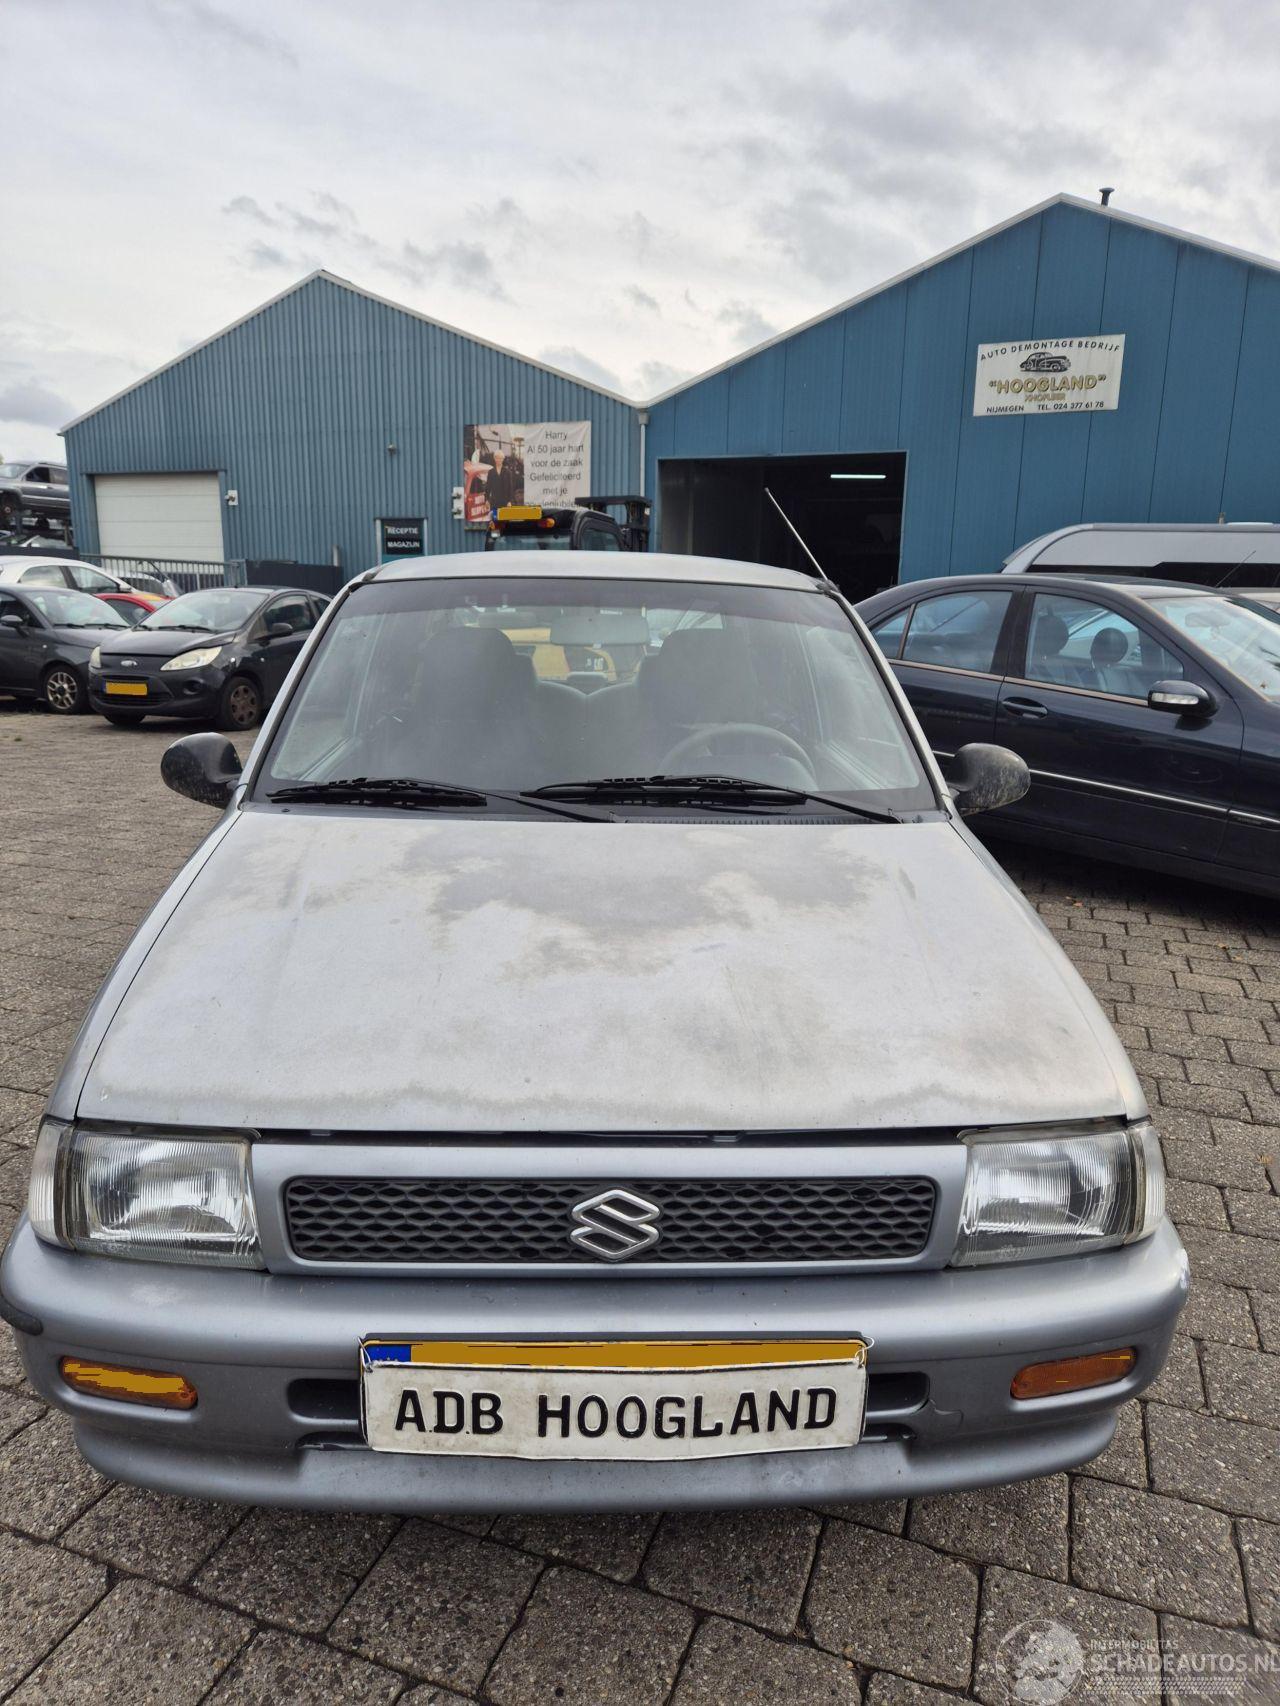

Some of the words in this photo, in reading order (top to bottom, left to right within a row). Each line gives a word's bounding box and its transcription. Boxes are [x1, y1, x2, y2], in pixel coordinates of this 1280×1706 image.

[981, 348, 1007, 360] AUTO
[1011, 340, 1073, 353] DEMONTAGE
[1078, 340, 1120, 352] BEDRIJF
[986, 405, 1024, 413] NIJMEGEN
[1038, 403, 1050, 411] TEL.
[1053, 402, 1068, 410] 024
[1085, 401, 1093, 409] 61
[545, 431, 568, 441] Harry
[527, 445, 536, 453] Al
[538, 445, 548, 453] 50
[549, 445, 565, 455] jaar
[568, 444, 584, 452] hart
[550, 458, 561, 466] de
[563, 458, 583, 467] zaak
[529, 472, 581, 481] Gefeliciteerd
[542, 487, 558, 495] met
[559, 486, 568, 496] je
[537, 1387, 837, 1438] HOOGLAND
